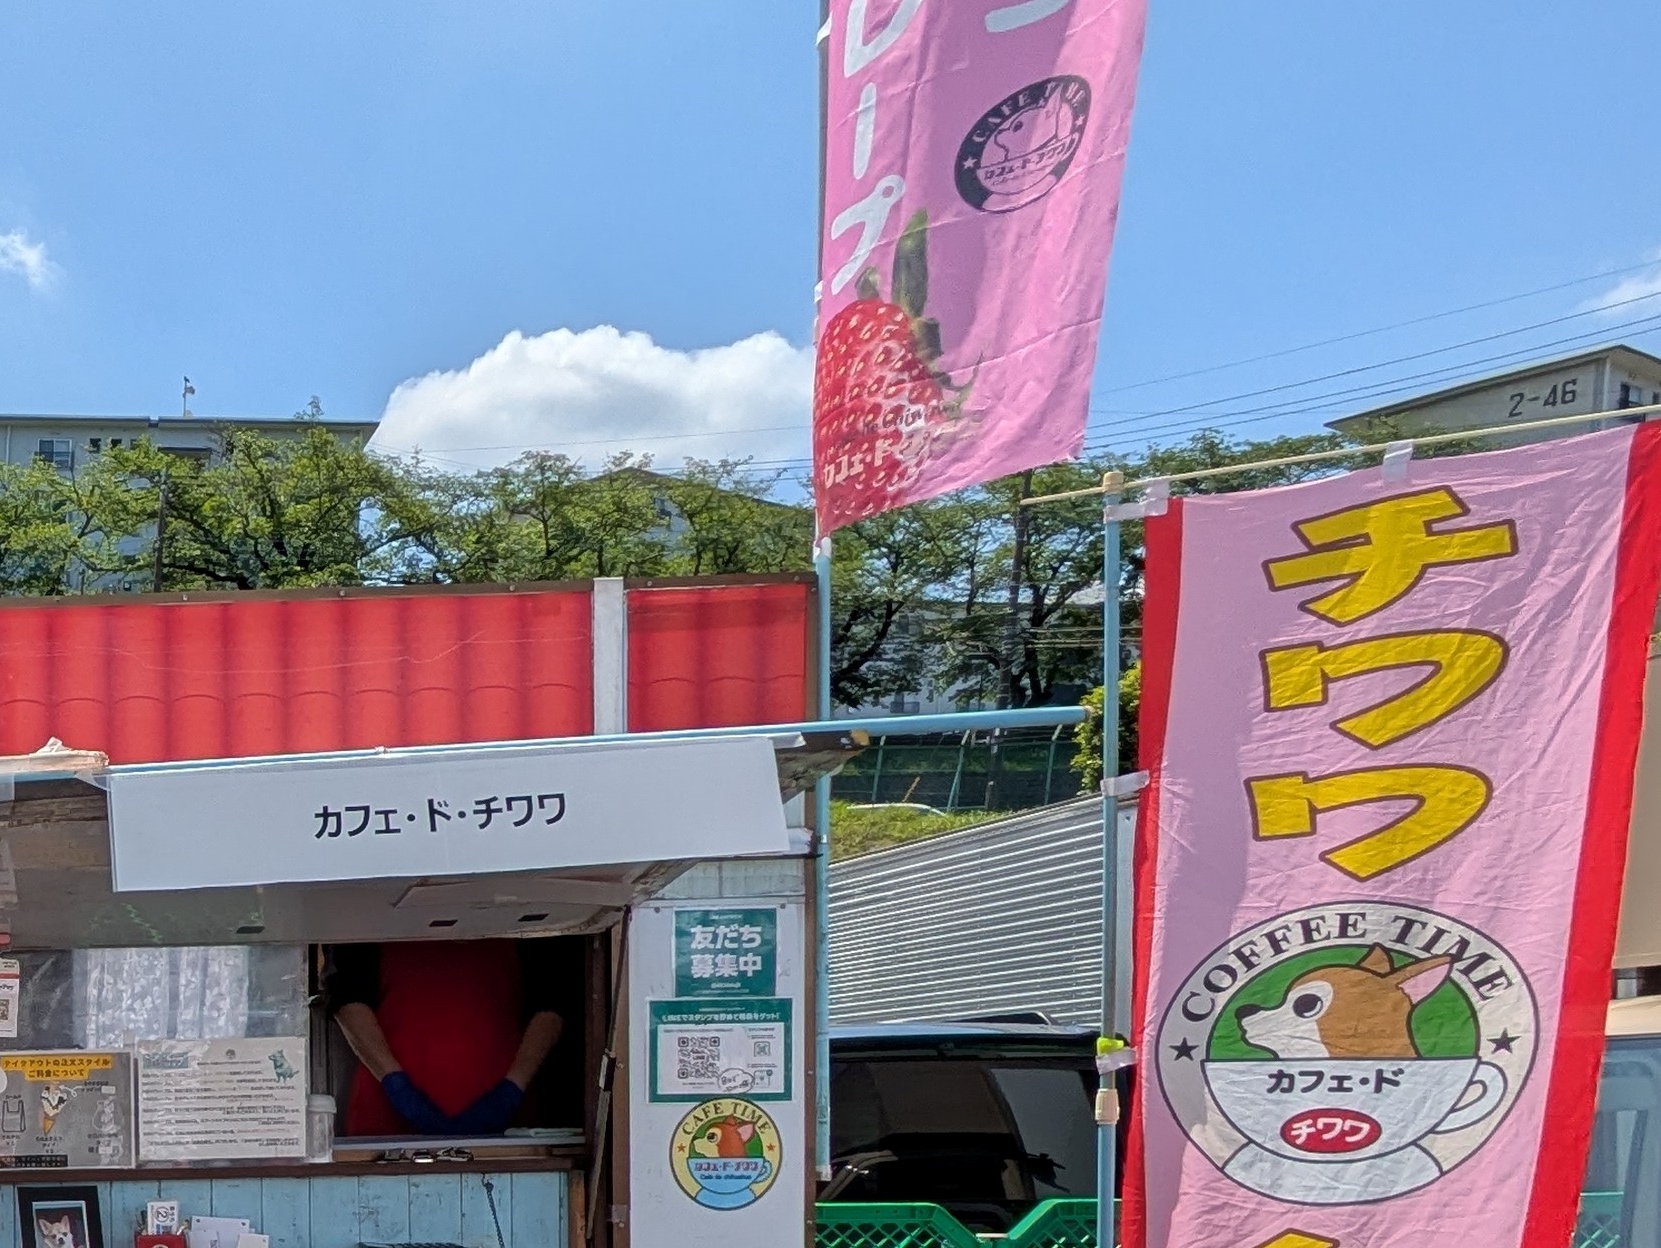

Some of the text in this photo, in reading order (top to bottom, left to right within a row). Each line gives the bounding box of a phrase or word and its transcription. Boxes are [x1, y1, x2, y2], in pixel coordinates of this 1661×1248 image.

[1508, 379, 1577, 418] 2-46
[1245, 485, 1519, 882] チワワ
[314, 793, 565, 839] カフェ・ド・チワワ
[690, 924, 762, 950] 友だち
[690, 952, 762, 978] 募集中
[1181, 911, 1514, 1023] COFFEE TIME
[1266, 1068, 1405, 1094] カフェ・ド
[682, 1102, 772, 1135] CAFE TIME
[1290, 1116, 1371, 1146] チワワ
